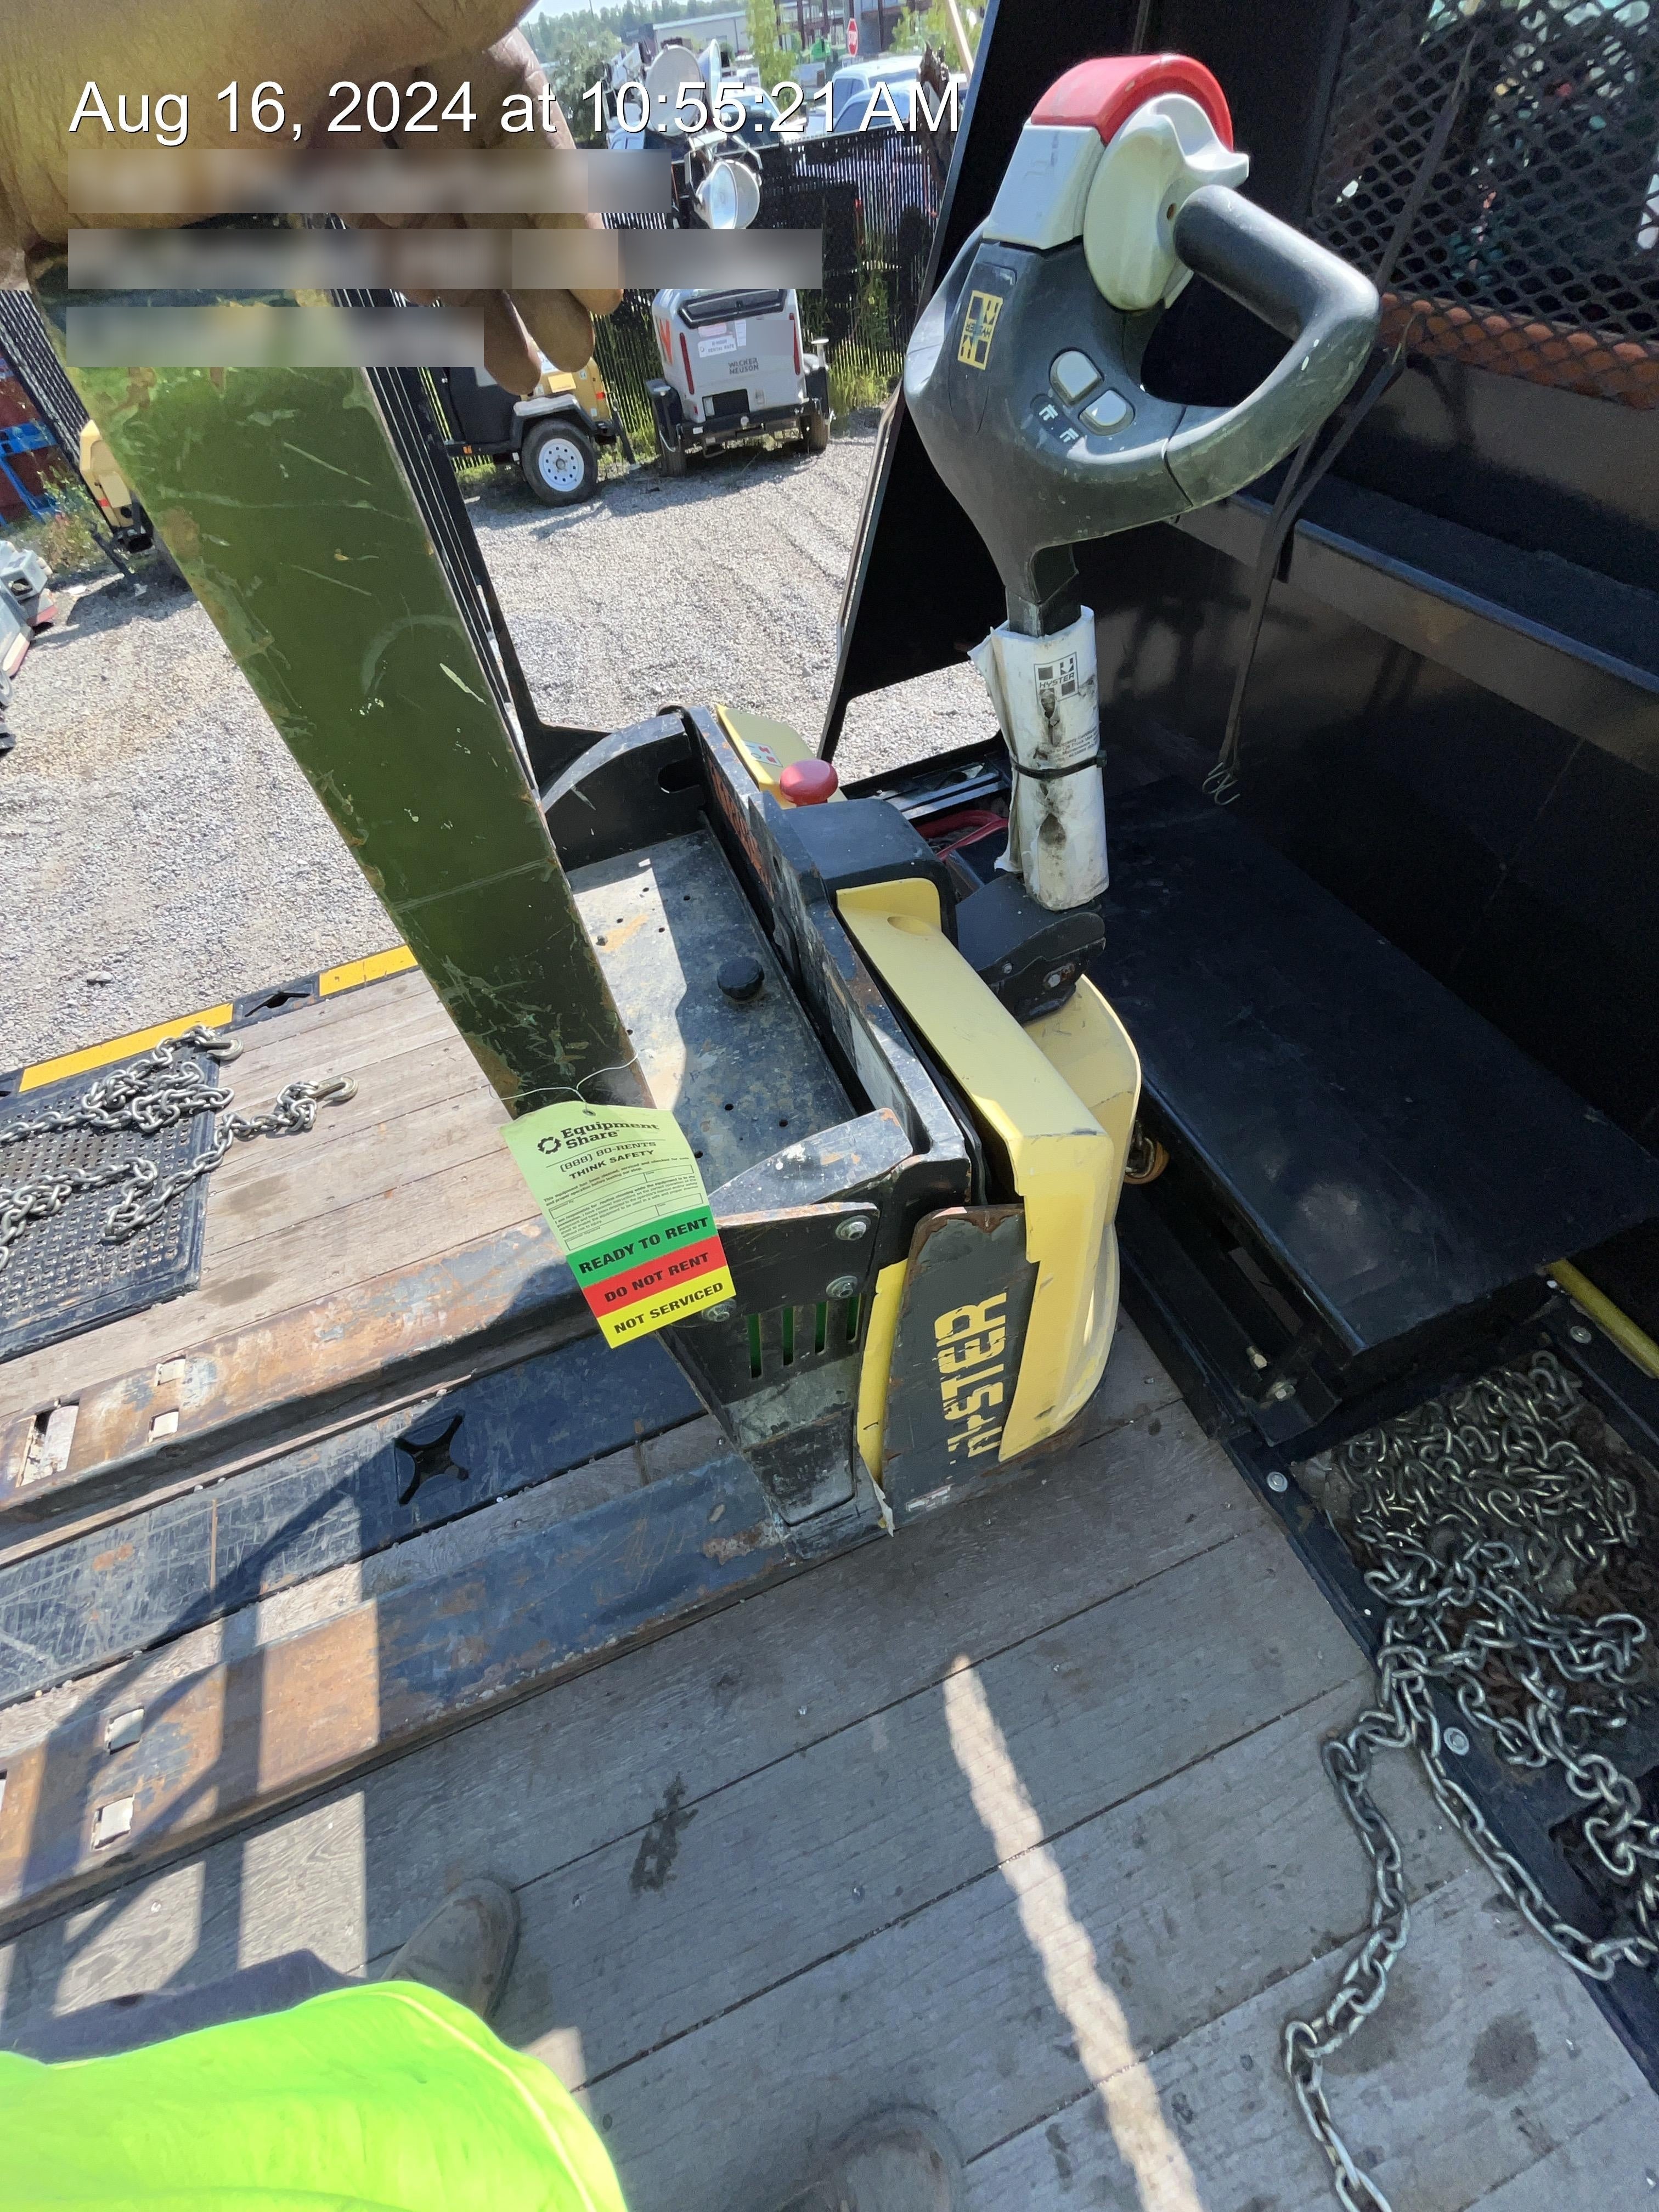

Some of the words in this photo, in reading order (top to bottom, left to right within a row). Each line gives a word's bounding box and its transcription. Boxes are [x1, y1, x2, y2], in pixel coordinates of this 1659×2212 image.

[729, 364, 759, 375] NEUSON
[1040, 672, 1074, 688] HYSTER
[561, 1122, 660, 1138] Equipment
[566, 1130, 618, 1149] Share
[560, 1154, 593, 1172] (888)
[596, 1142, 656, 1156] 80-RENTS
[569, 1160, 607, 1179] THINK
[610, 1150, 654, 1163] SAFETY
[579, 1243, 634, 1273] READY
[639, 1234, 660, 1249] TO
[665, 1217, 708, 1239] RENT
[605, 1286, 628, 1302] DO
[632, 1271, 662, 1290] NOT
[668, 1252, 708, 1276] RENT
[614, 1314, 644, 1333] NOT
[650, 1282, 723, 1319] SERVICED
